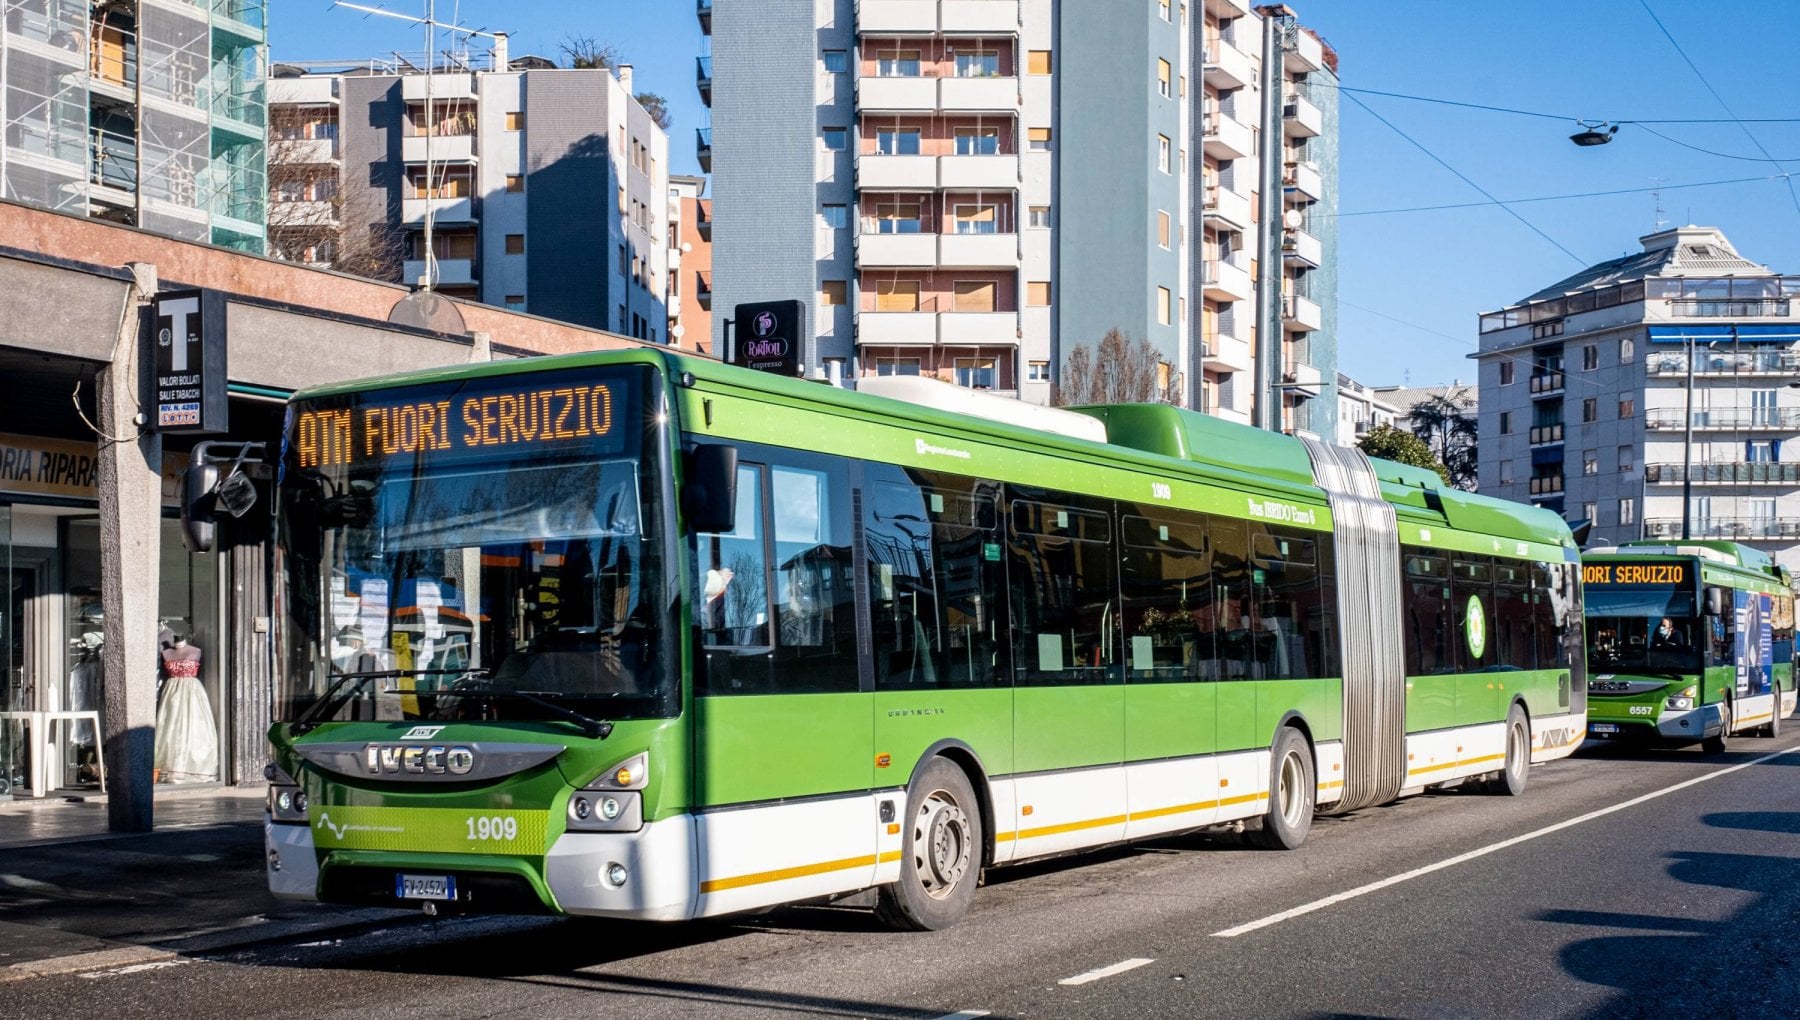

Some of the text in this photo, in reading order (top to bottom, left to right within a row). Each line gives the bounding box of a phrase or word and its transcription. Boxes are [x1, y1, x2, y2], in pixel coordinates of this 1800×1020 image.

[158, 297, 199, 371] T
[159, 374, 200, 387] VALORI BOLLATI
[159, 389, 200, 400] SALI E TABACCHI
[300, 408, 352, 468] ATM
[365, 401, 451, 457] FUORI
[463, 384, 613, 447] SERVIZIO
[0, 447, 32, 482] RIA
[1152, 482, 1171, 500] 1909
[1264, 501, 1291, 521] IBRIDO
[1615, 566, 1684, 583] SERVIZIO
[1629, 706, 1653, 715] 6557
[367, 745, 474, 775] IVECO
[466, 816, 517, 841] 1909
